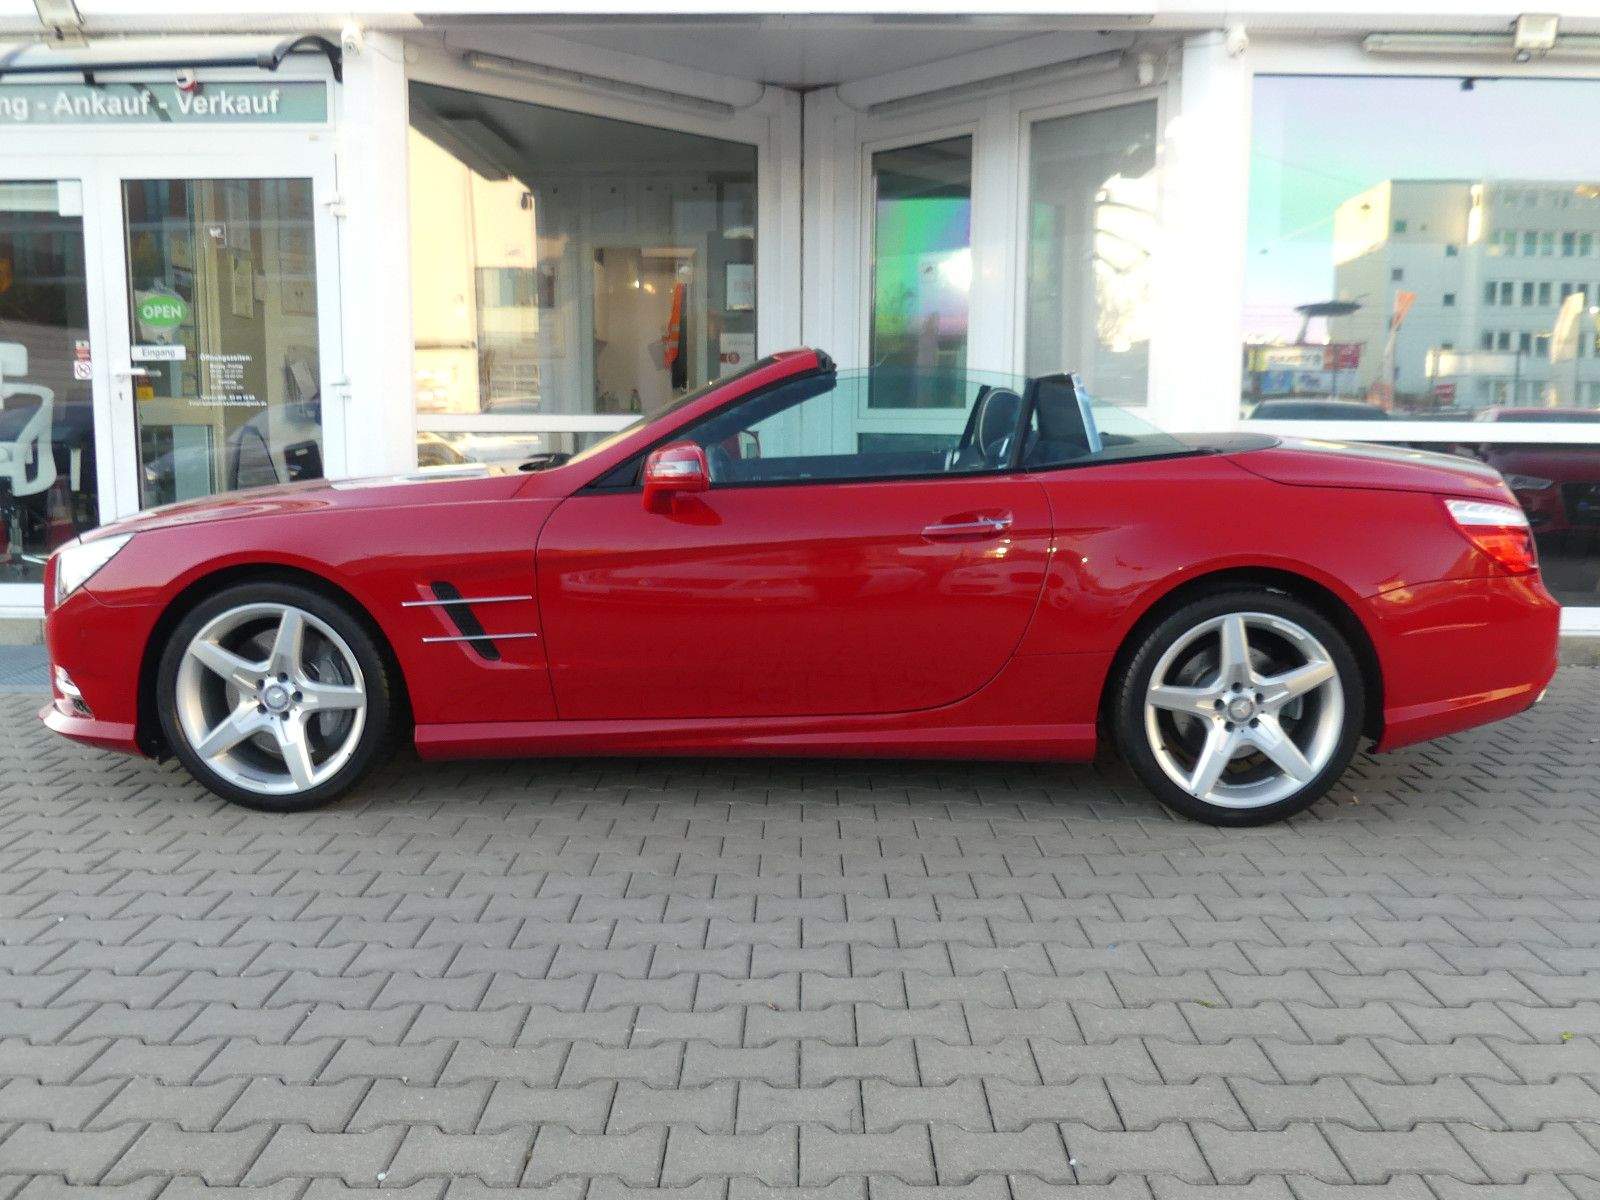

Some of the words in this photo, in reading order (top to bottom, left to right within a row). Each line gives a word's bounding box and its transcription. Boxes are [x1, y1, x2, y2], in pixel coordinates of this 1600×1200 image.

[54, 90, 152, 116] Ankauf
[176, 89, 281, 115] Verkauf
[142, 305, 183, 320] OPEN
[142, 347, 176, 359] Eingang
